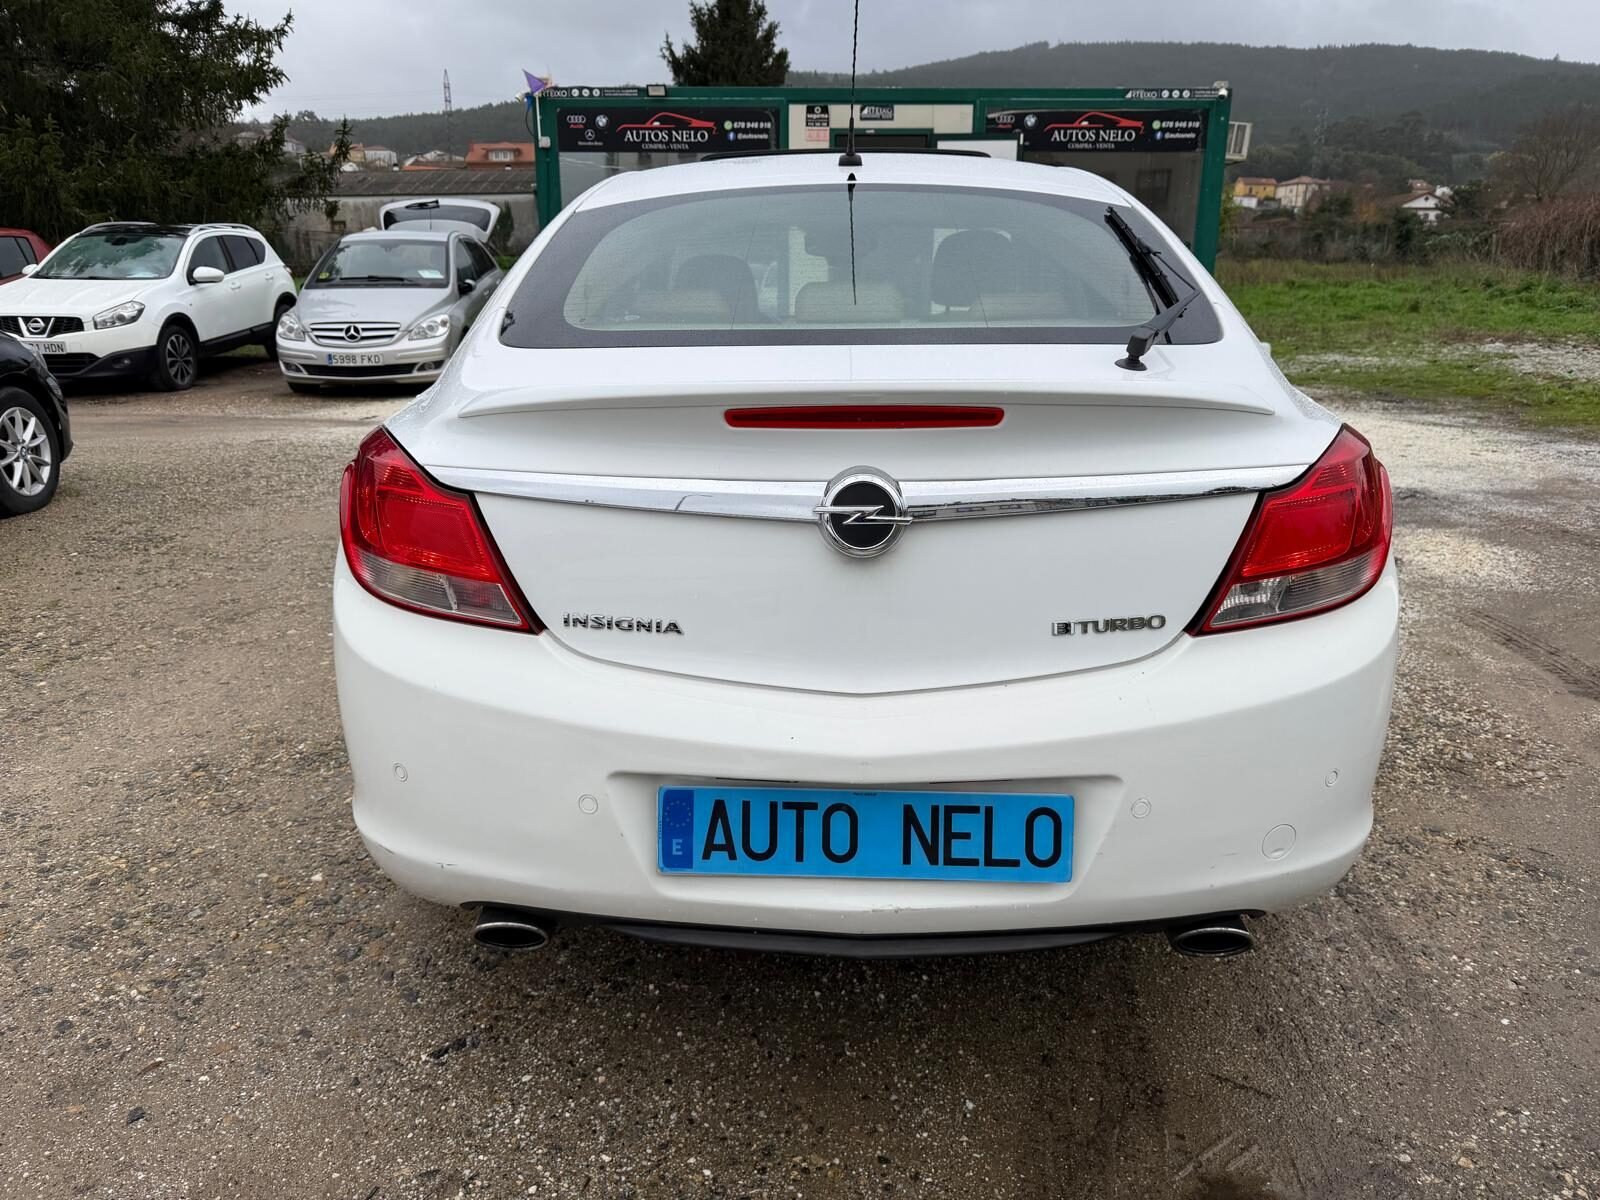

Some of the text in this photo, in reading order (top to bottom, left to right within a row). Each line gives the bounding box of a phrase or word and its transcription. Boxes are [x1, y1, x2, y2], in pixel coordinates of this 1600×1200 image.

[1125, 90, 1157, 98] ARTEIXO
[624, 129, 709, 142] AUTOS NELO
[1051, 129, 1136, 142] AUTOS NELO
[43, 344, 64, 353] HDN
[332, 354, 381, 364] 5998 FKD
[562, 612, 685, 636] INSIGNIA
[1051, 614, 1167, 637] BITURBO
[701, 798, 1063, 869] AUTO NELO
[672, 838, 683, 856] E
